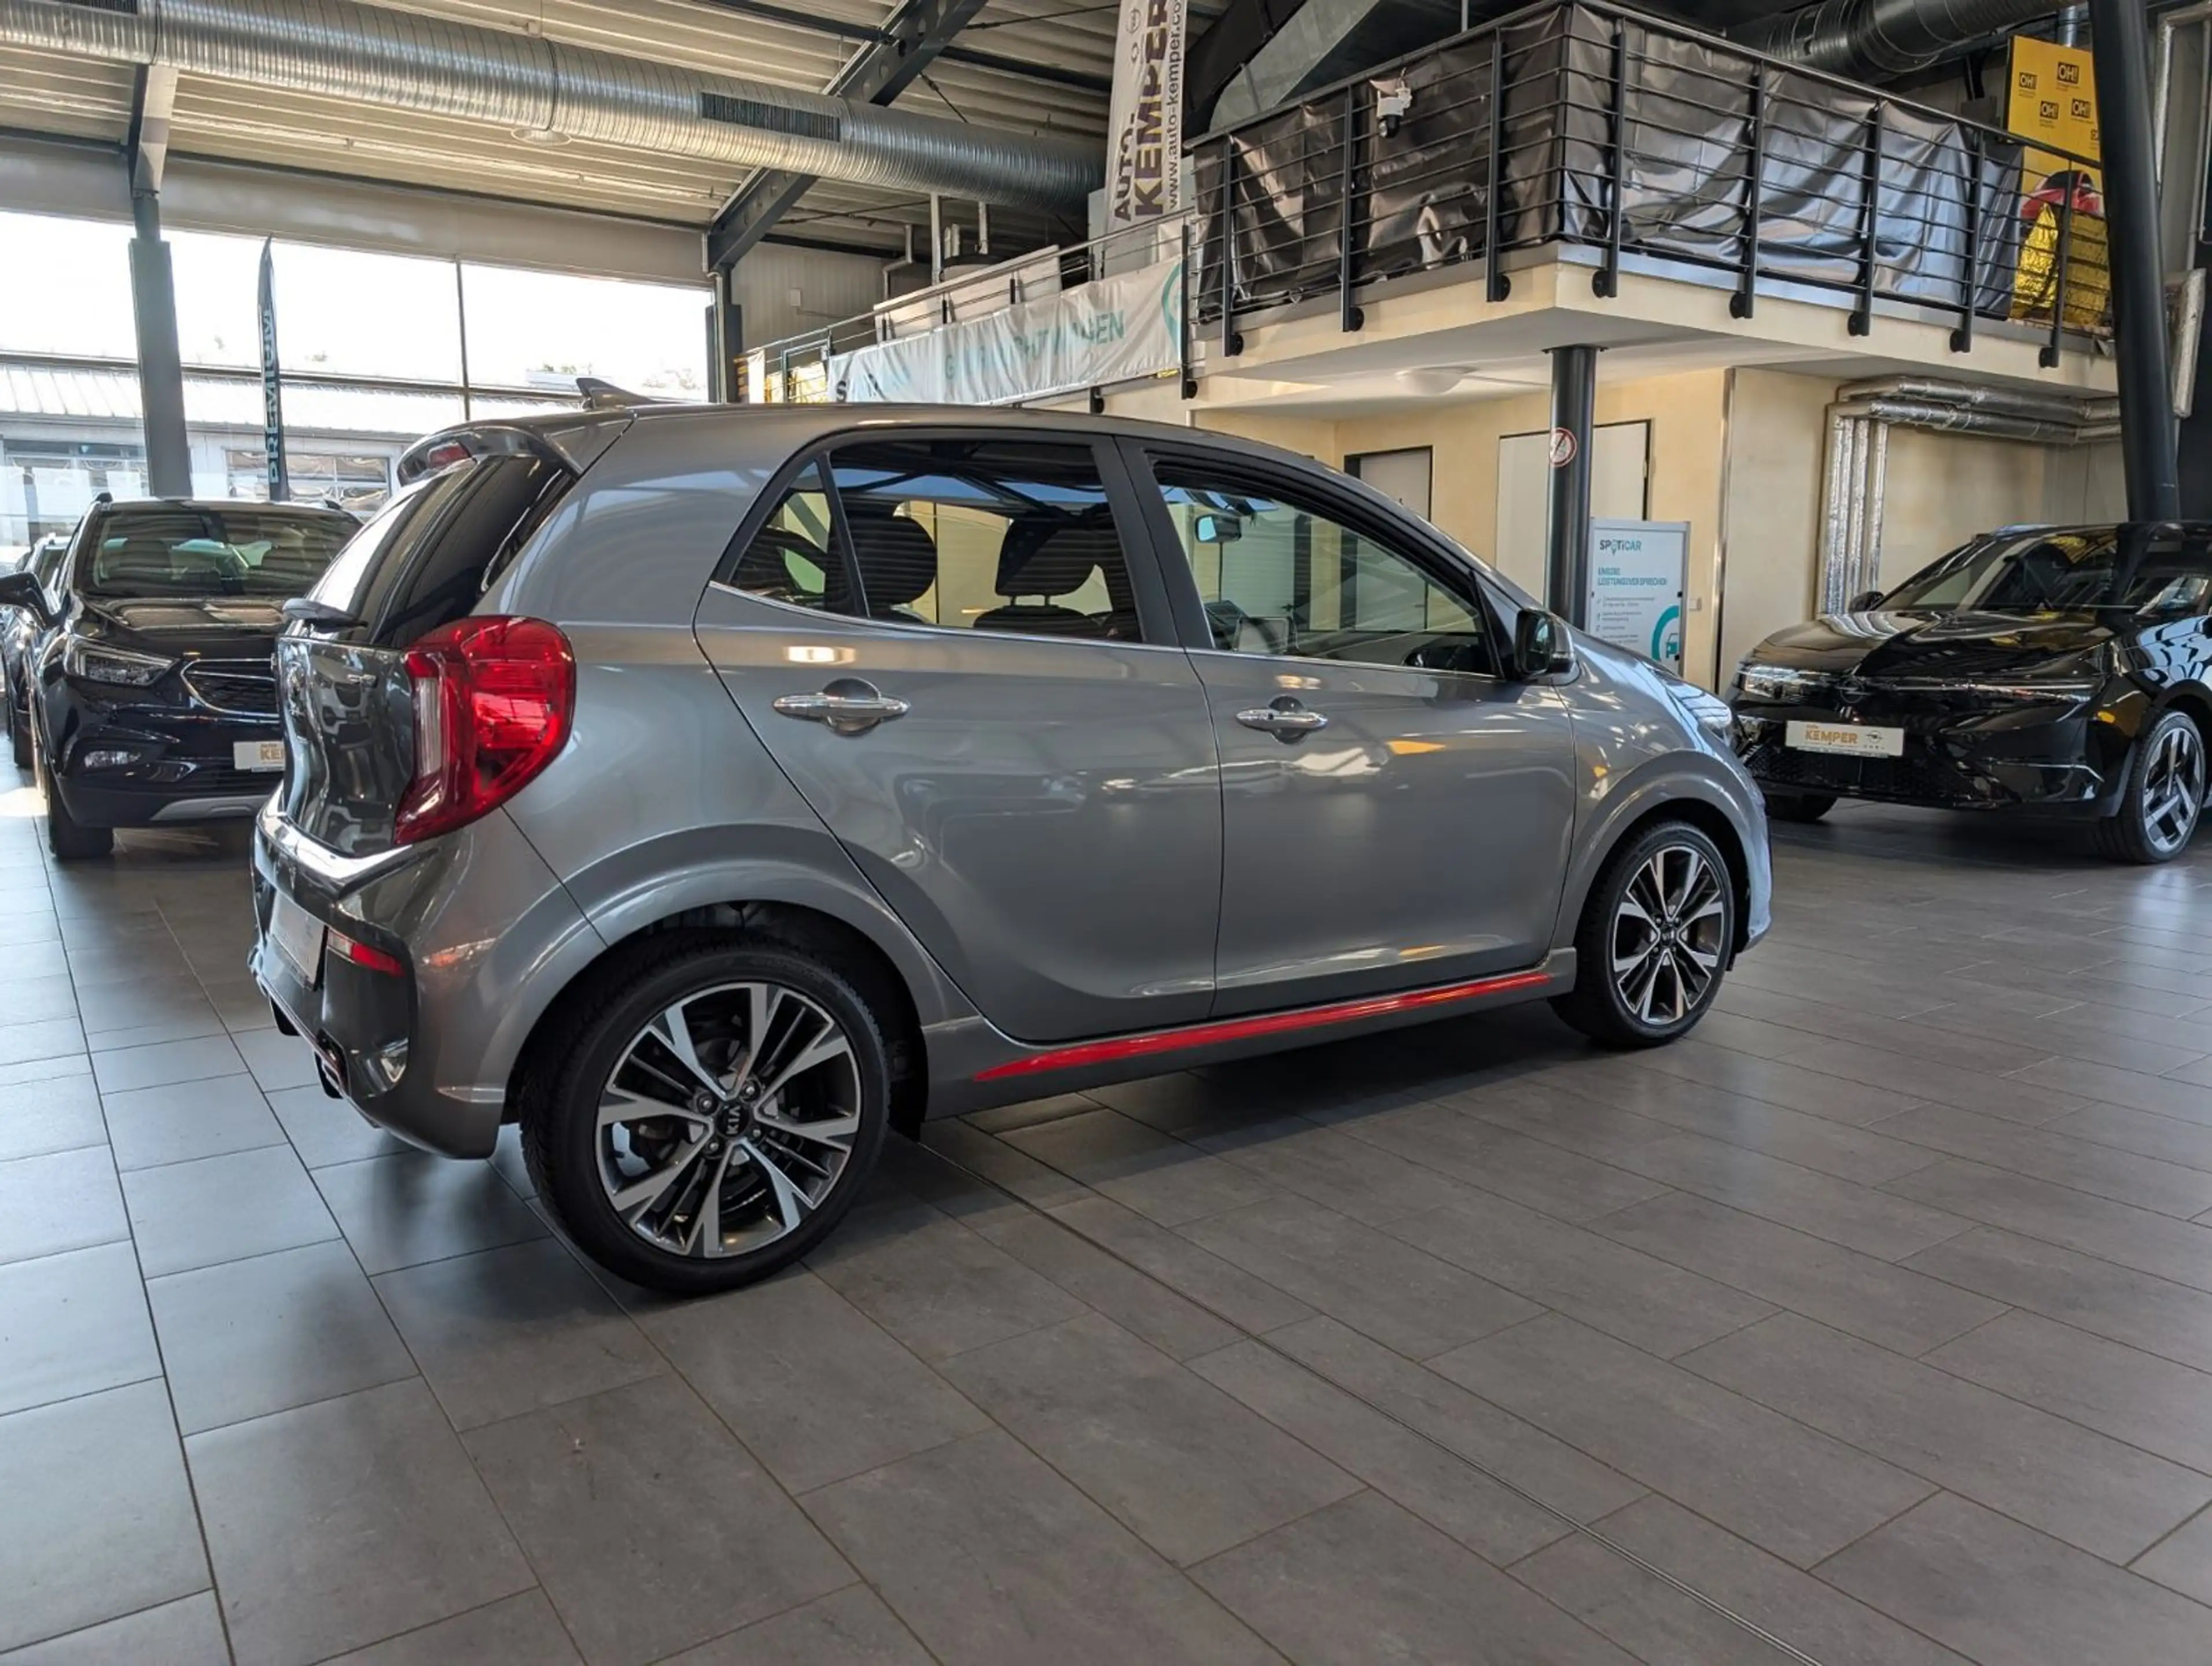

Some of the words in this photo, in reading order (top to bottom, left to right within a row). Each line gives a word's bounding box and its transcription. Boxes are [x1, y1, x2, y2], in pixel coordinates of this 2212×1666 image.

[1165, 0, 1183, 210] www.auto-kemper.co
[2058, 64, 2078, 82] OH!
[1134, 0, 1168, 216] KEMPER
[1114, 113, 1135, 222] AUTO-
[262, 309, 279, 484] PREMIUM
[260, 746, 285, 761] KE
[1806, 729, 1858, 744] KEMPER
[726, 1105, 741, 1134] KIA
